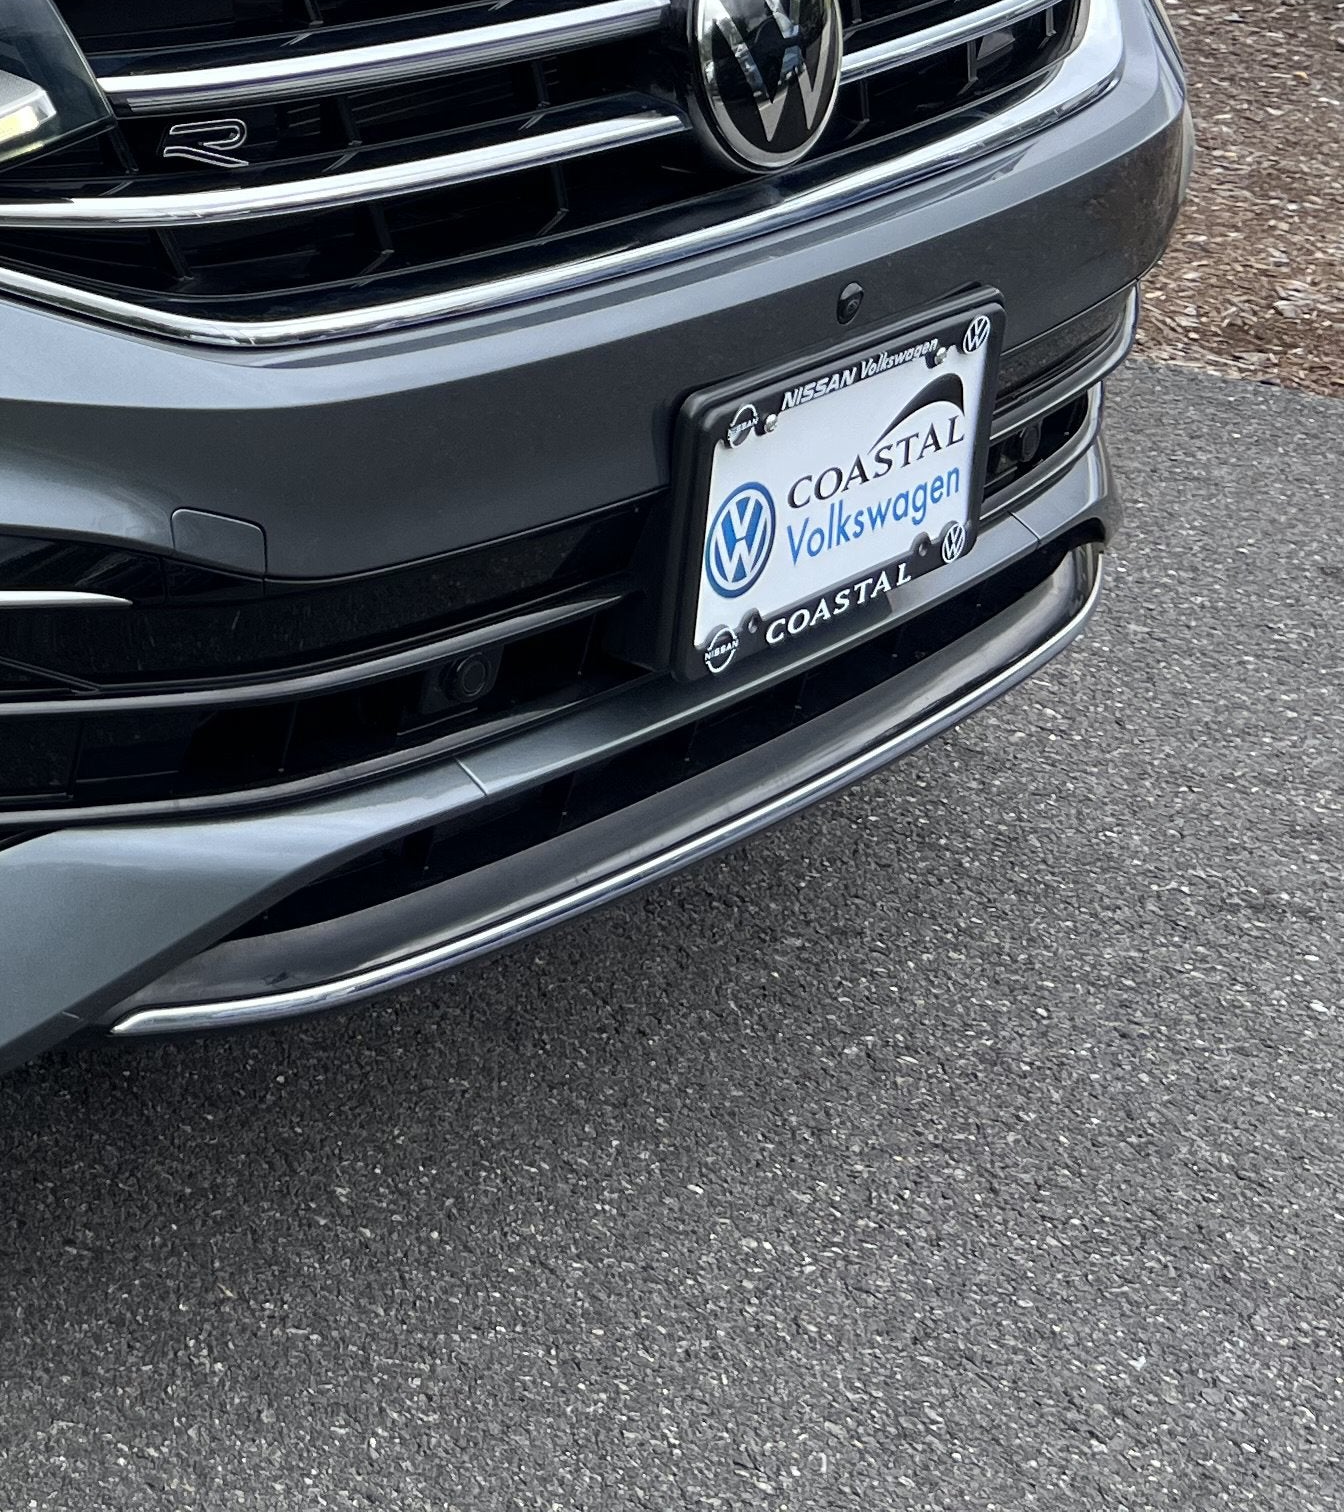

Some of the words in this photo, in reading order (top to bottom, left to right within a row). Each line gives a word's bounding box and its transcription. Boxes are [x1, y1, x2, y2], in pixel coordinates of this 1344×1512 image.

[163, 118, 250, 168] R
[781, 366, 856, 411] NISSAN
[859, 337, 939, 381] Volkswagen
[786, 415, 965, 509] COASTAL
[786, 466, 960, 567] Volkswagen
[764, 564, 912, 645] COASTAL
